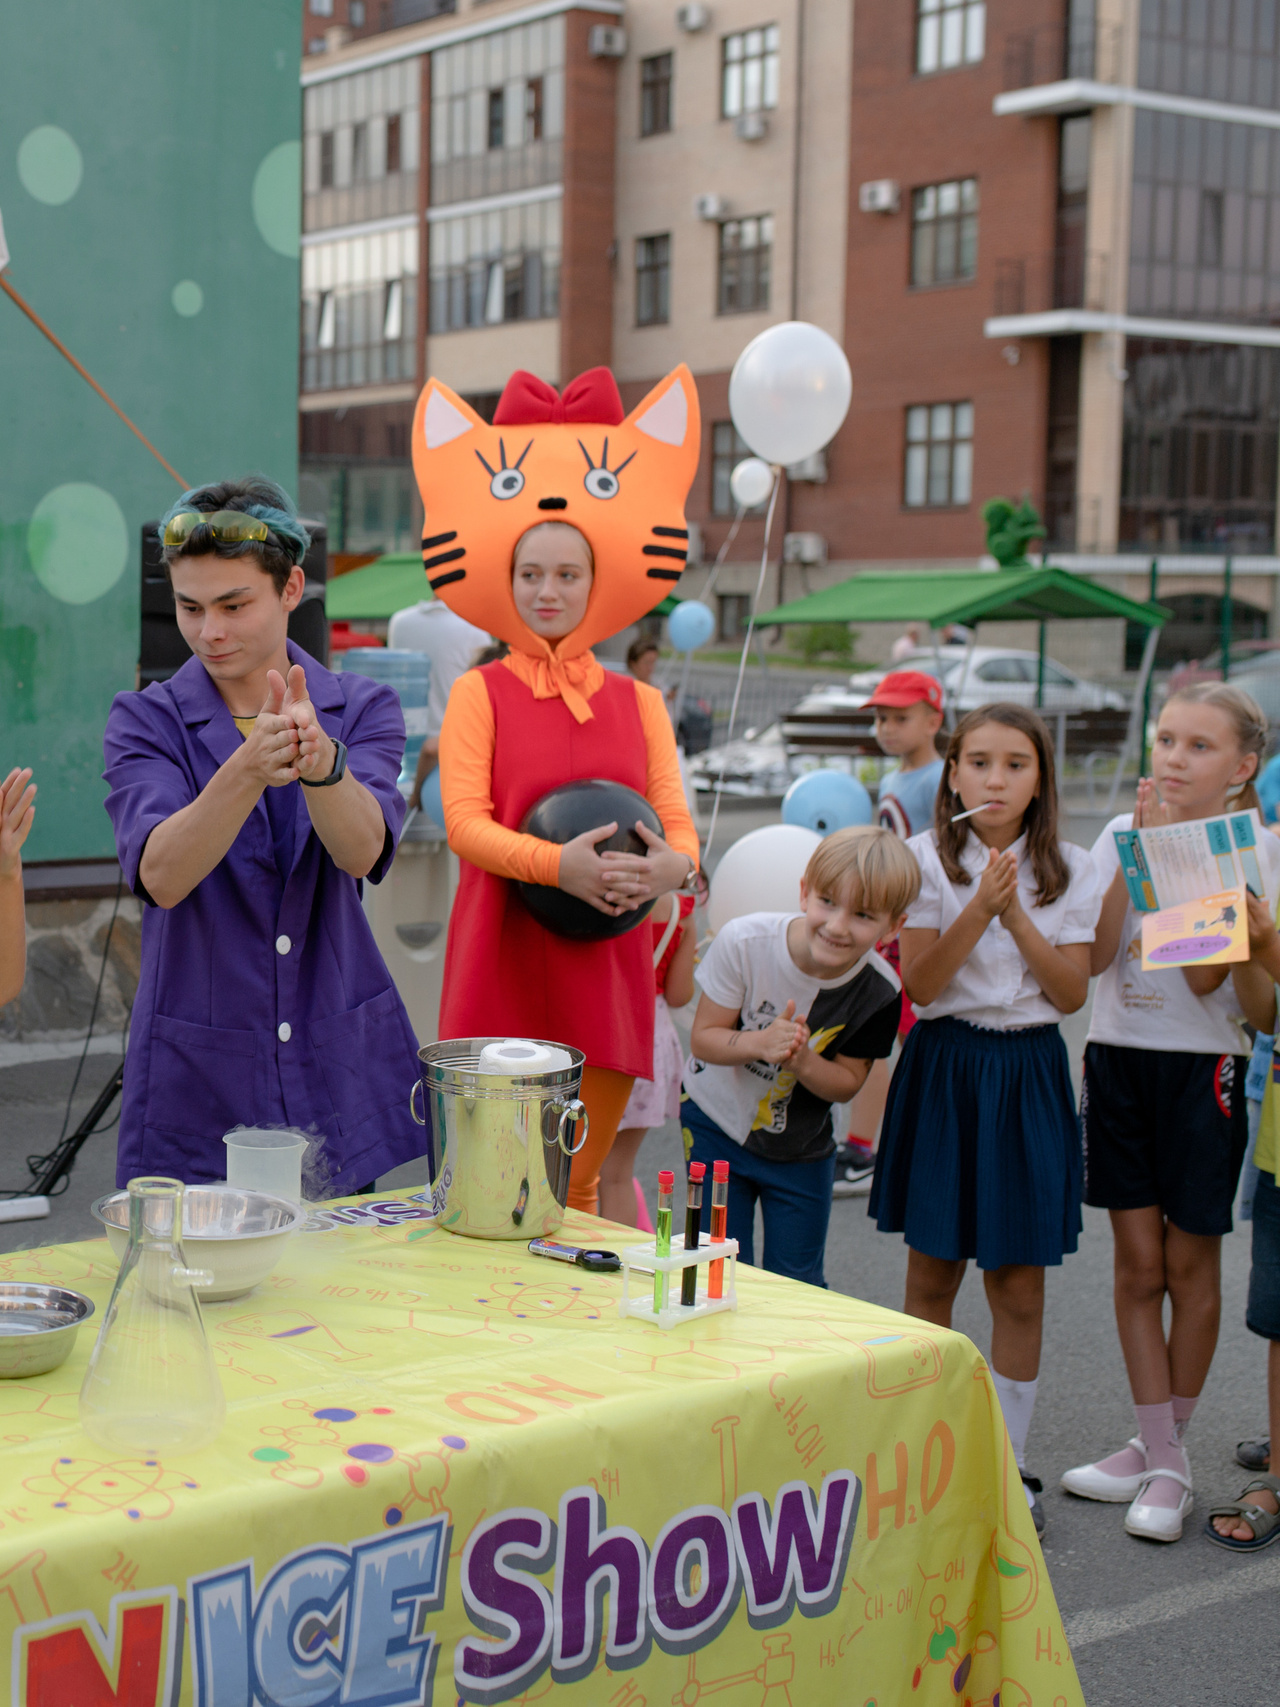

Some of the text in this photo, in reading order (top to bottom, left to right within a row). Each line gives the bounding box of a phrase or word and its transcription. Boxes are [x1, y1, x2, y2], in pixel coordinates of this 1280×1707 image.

[444, 1373, 605, 1426] H2O
[865, 1418, 956, 1541] H2O
[12, 1466, 858, 1707] NICE Show
